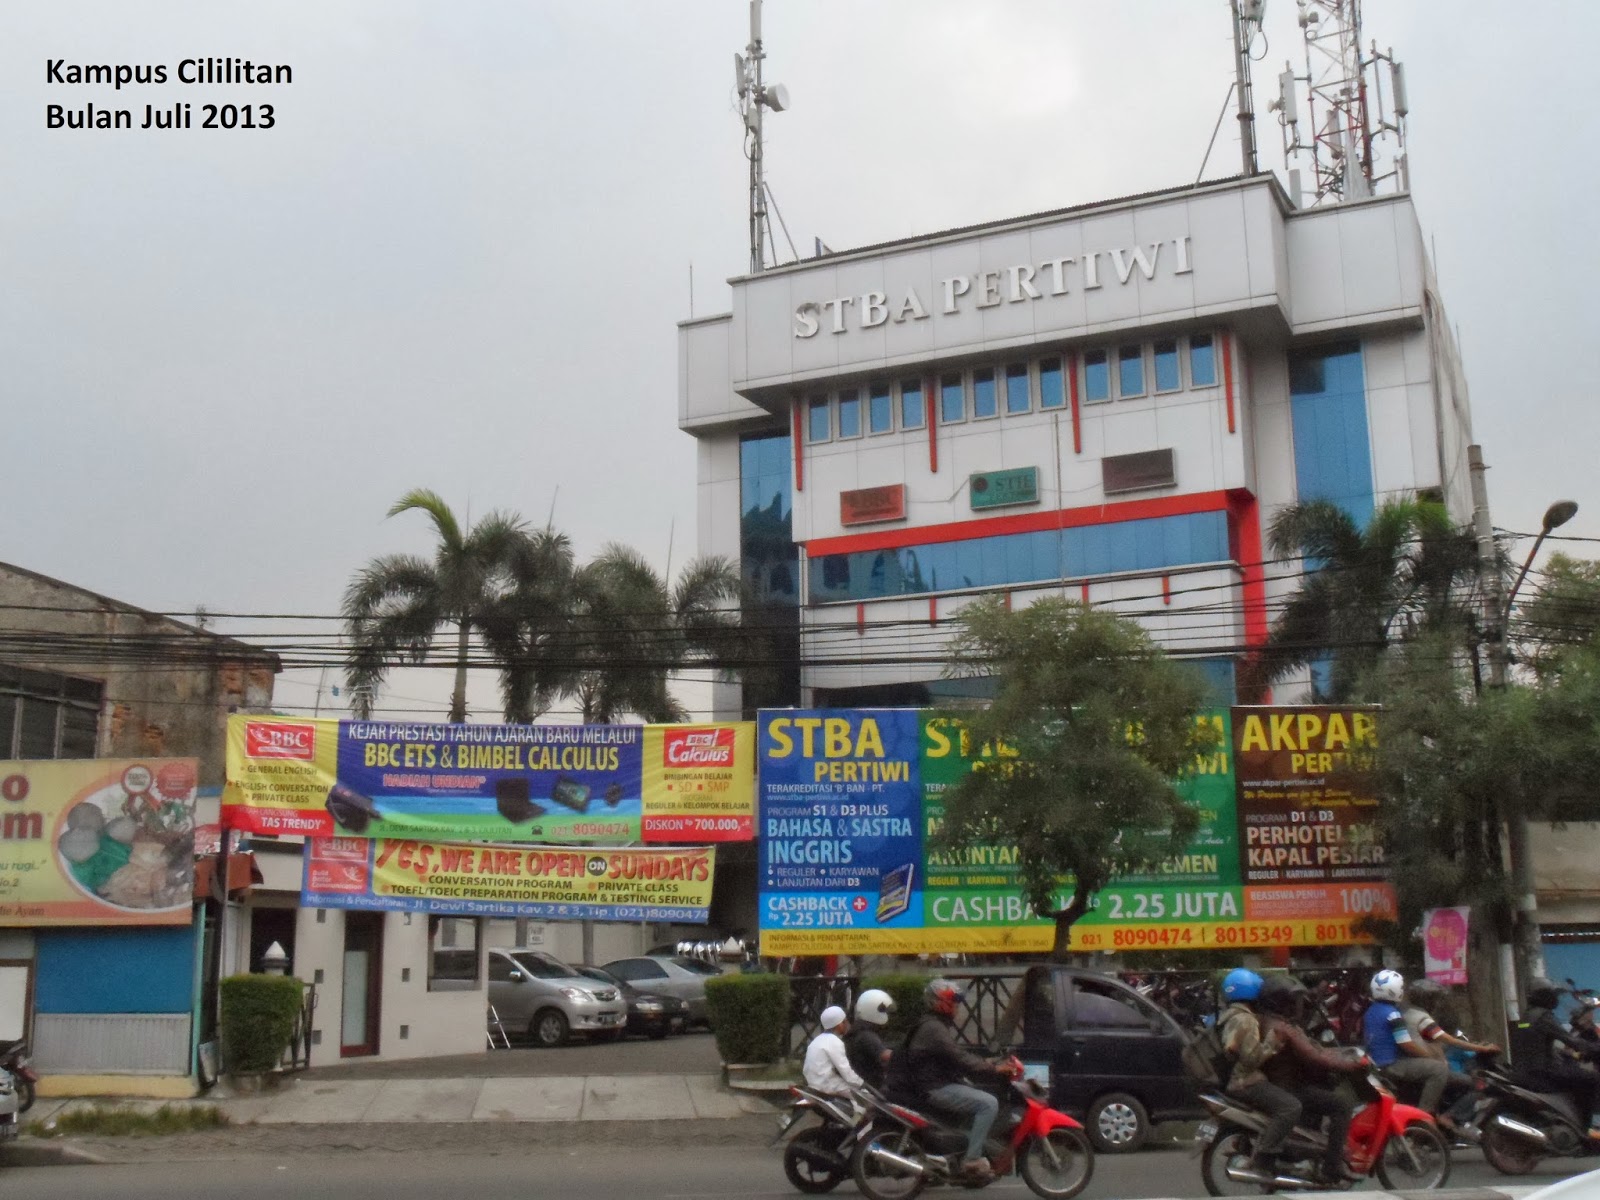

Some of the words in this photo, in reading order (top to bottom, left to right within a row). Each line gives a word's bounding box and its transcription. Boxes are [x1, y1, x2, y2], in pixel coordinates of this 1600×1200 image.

[794, 286, 930, 339] STBA
[941, 235, 1194, 315] PERTIWI
[269, 731, 309, 747] BBC
[349, 723, 387, 740] KEJAR
[389, 724, 446, 742] PRESTASI
[449, 726, 492, 743] TAHUN
[494, 727, 543, 743] AJARAN
[546, 727, 580, 744] BARU
[582, 728, 636, 744] MELALUI
[768, 717, 886, 758] STBA
[364, 742, 401, 768] BBC
[404, 744, 436, 768] ETS
[439, 744, 453, 768] &
[457, 745, 525, 769] BIMBEL
[527, 746, 619, 771] CALCULUS
[668, 740, 730, 763] Calculus
[247, 766, 284, 774] GENERAL
[814, 761, 910, 783] PERTIWI
[268, 784, 329, 793] CONVERSATION
[707, 781, 730, 792] SMP
[767, 784, 833, 793] TERAKREDITASI
[846, 784, 865, 793] BAN
[251, 793, 286, 802] PRIVATE
[286, 795, 310, 803] CLASS
[683, 802, 720, 810] KELOMPOK
[721, 802, 750, 810] BELAJAR
[767, 807, 812, 816] PROGRAM
[813, 805, 827, 816] S1
[829, 805, 839, 816] &
[840, 805, 857, 816] D3
[859, 805, 889, 816] PLUS
[261, 816, 281, 828] TAS
[1291, 811, 1306, 822] D1
[1318, 810, 1335, 822] D3
[573, 823, 630, 836] 8090474
[645, 819, 684, 831] DISKON
[767, 818, 833, 837] BAHASA
[836, 819, 848, 837] &
[851, 818, 913, 837] SASTRA
[767, 840, 853, 864] INGGRIS
[1248, 848, 1313, 867] KAPAL
[440, 848, 475, 874] WE
[478, 850, 521, 876] ARE
[525, 852, 587, 878] OPEN
[588, 861, 606, 872] ON
[607, 854, 709, 882] SUNDAYS
[777, 868, 816, 877] REGULER
[829, 867, 880, 876] KARYAWAN
[1248, 871, 1279, 880] REGULER
[1285, 870, 1325, 879] KARYAWAN
[428, 875, 514, 887] CONVERSATION
[516, 879, 573, 890] PROGRAM
[598, 881, 643, 892] PRIVATE
[644, 883, 679, 893] CLASS
[777, 878, 823, 887] LANJUTAN
[824, 878, 846, 887] DARI
[847, 878, 861, 887] D3
[391, 884, 461, 897] TOEFL/TOEIC
[463, 888, 539, 900] PREPARATION
[541, 892, 598, 902] PROGRAM
[599, 893, 608, 902] &
[610, 893, 656, 904] TESTING
[656, 895, 703, 905] SERVICE
[430, 900, 465, 911] Dewi
[467, 901, 515, 913] Sartika
[517, 904, 543, 914] Kav.
[546, 905, 555, 914] 2
[557, 906, 568, 915] &
[767, 896, 848, 911] CASHBACK
[1108, 893, 1165, 919] 2.25
[1171, 891, 1238, 918] JUTA
[768, 912, 779, 921] Rp
[781, 912, 814, 926] 2.25
[817, 911, 854, 926] JUTA
[1081, 934, 1101, 945] 021
[1113, 928, 1193, 946] 8090474
[1215, 925, 1293, 944] 8015349
